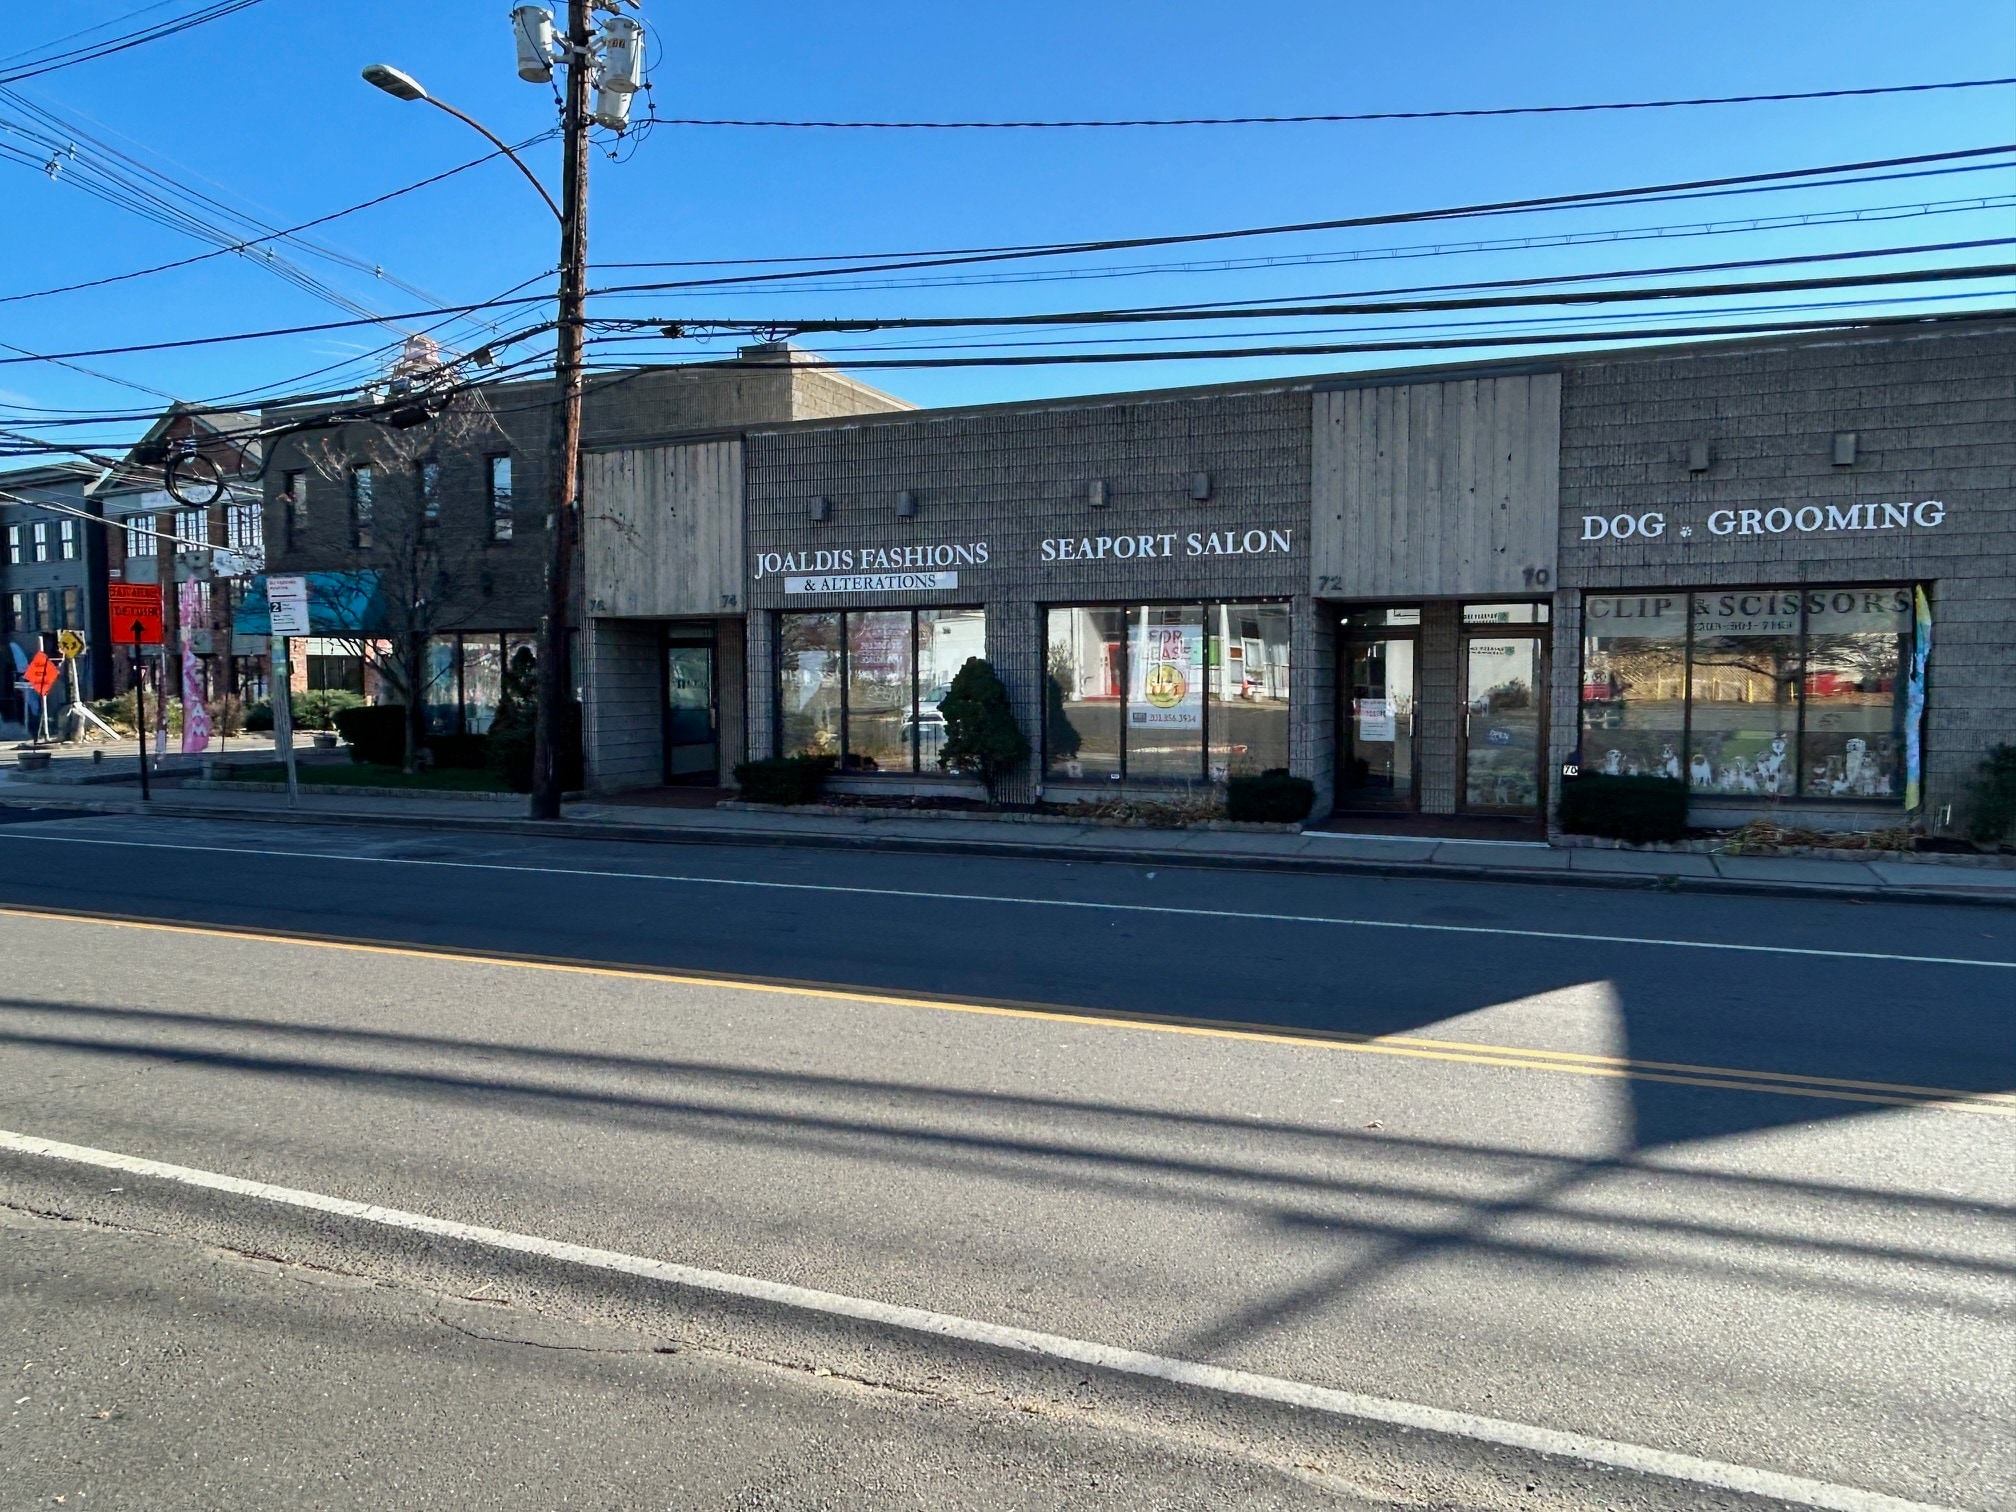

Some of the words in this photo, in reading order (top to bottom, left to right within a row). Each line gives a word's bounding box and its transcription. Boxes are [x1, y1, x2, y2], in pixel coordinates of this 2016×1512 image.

[1581, 512, 1666, 540] DOG
[1707, 500, 1947, 535] GROOMING
[1041, 532, 1178, 561] SEAPORT
[1186, 529, 1293, 556] SALON
[754, 549, 854, 579] JOALDIS
[859, 542, 989, 571] FASHIONS
[804, 579, 816, 592] &
[821, 574, 937, 592] ALTERATIONS
[1318, 575, 1343, 591] 72
[1521, 567, 1550, 586] 70
[271, 602, 280, 612] 2
[720, 594, 738, 608] 74
[1588, 598, 1672, 619] CLIP
[1696, 598, 1710, 615] &
[1718, 591, 1911, 617] SCISSORS
[1141, 646, 1191, 660] EASE
